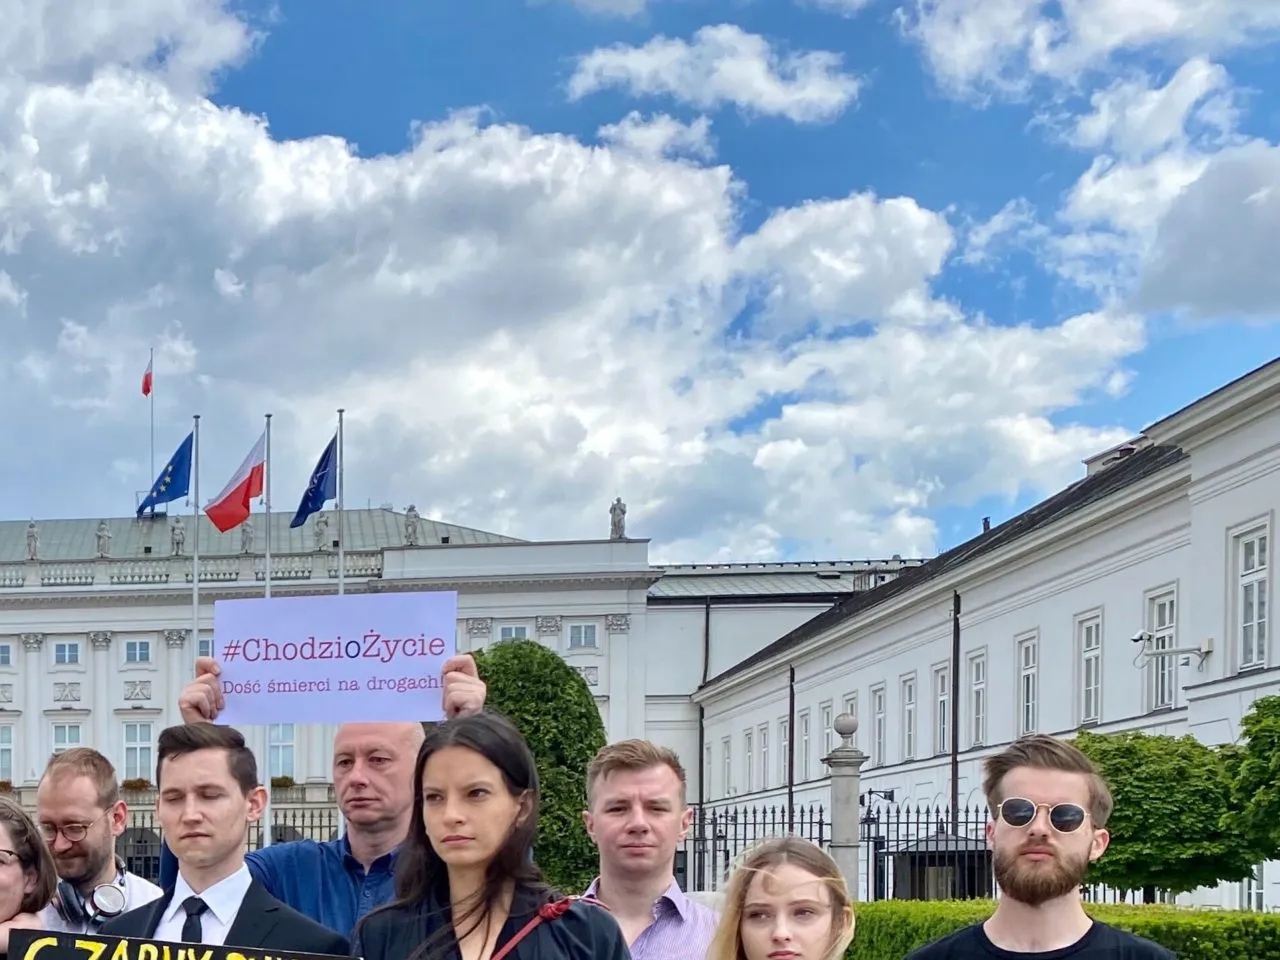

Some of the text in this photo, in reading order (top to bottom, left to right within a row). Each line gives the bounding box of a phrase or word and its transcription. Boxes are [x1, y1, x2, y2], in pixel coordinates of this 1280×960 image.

[222, 628, 445, 663] #ChodzioŻycie
[222, 679, 261, 694] Dość
[267, 677, 331, 694] śmierci
[338, 680, 360, 692] na
